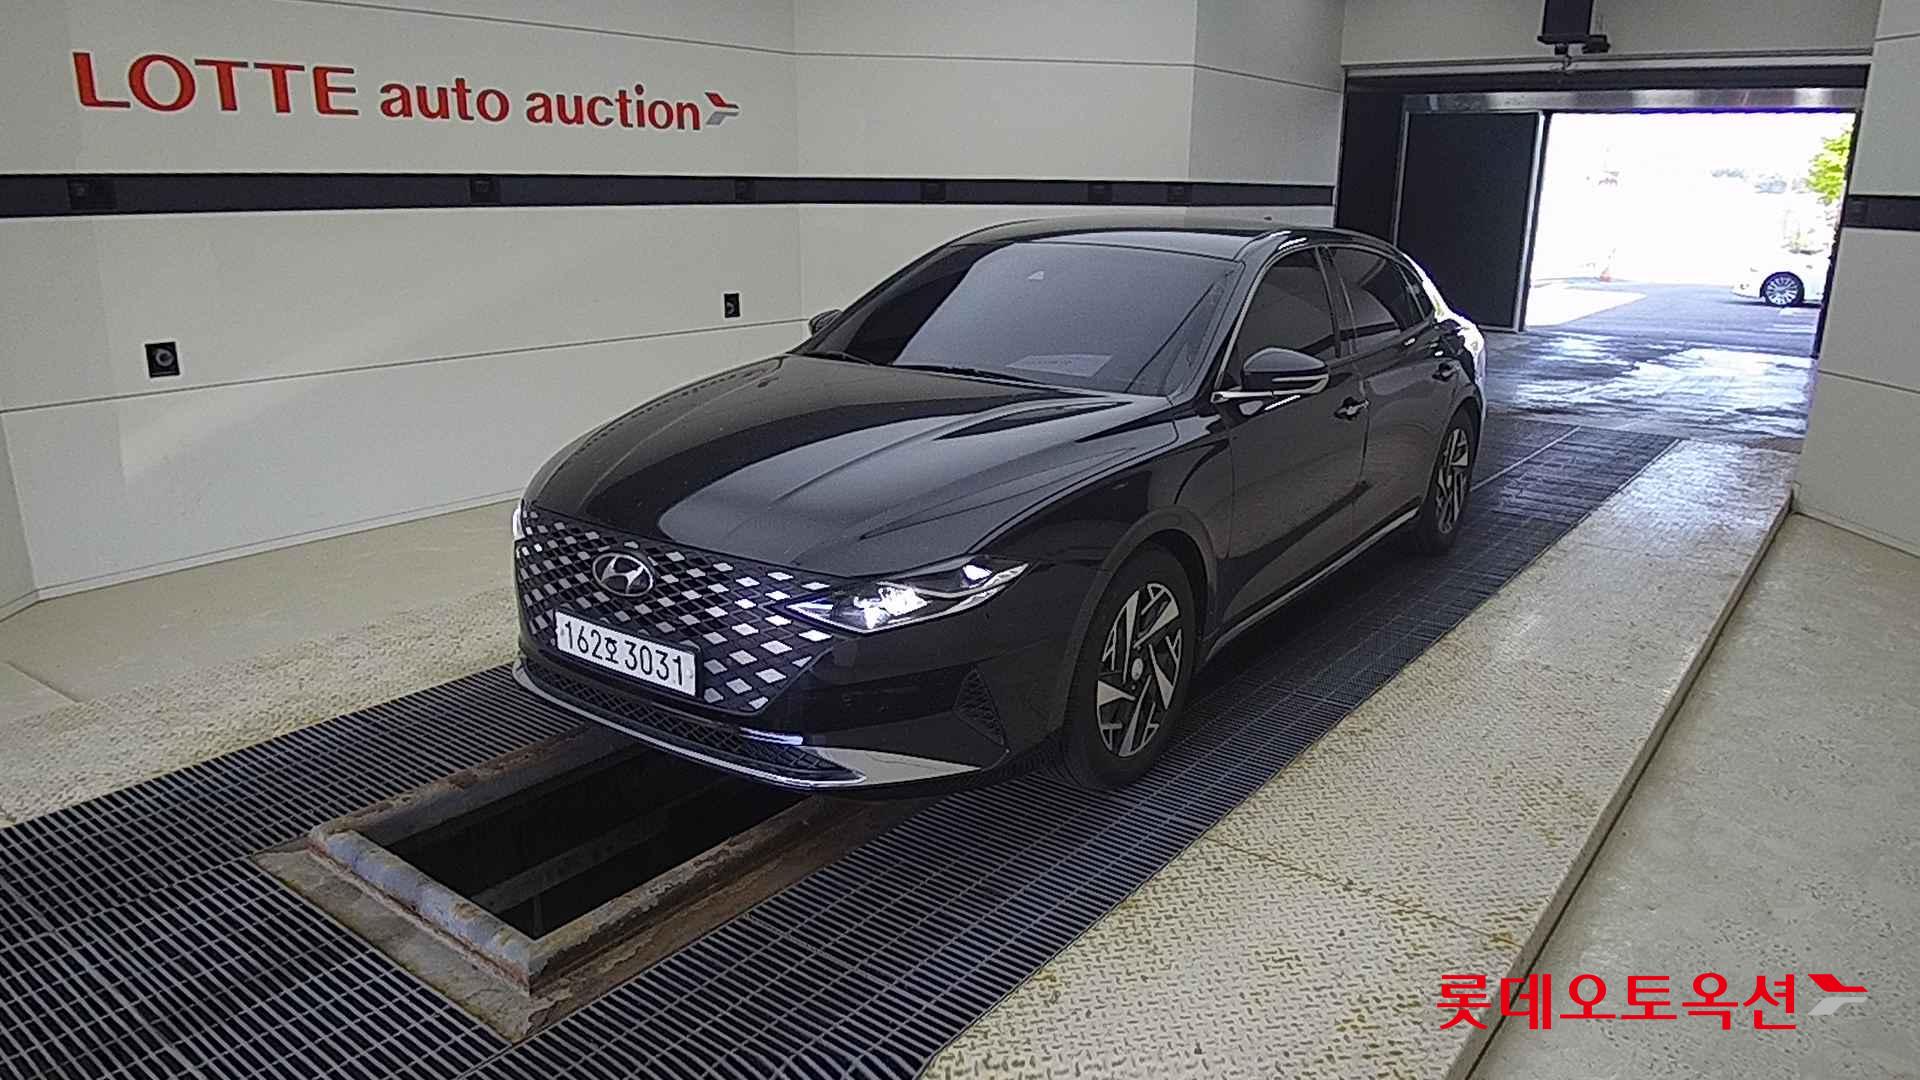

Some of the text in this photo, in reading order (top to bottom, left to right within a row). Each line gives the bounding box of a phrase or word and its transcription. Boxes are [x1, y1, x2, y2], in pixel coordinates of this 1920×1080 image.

[74, 53, 700, 129] LOTTE auto auction
